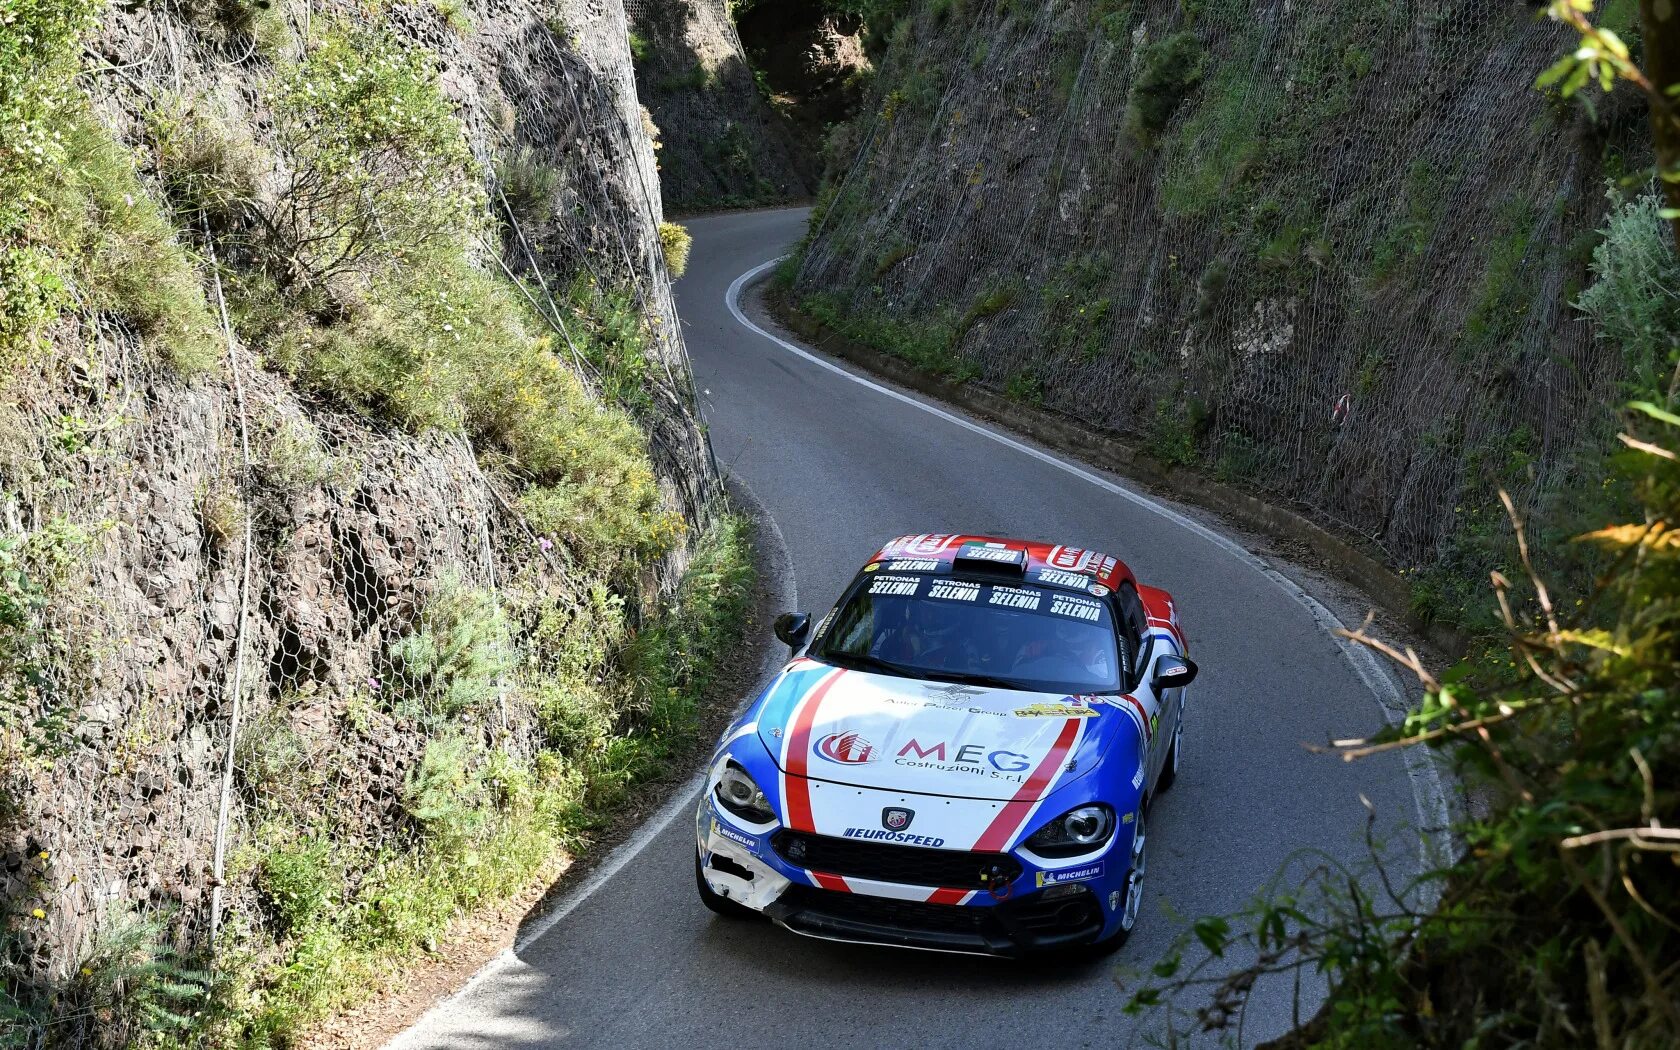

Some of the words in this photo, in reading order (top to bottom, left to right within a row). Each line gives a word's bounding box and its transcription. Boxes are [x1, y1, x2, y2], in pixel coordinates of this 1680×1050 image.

[966, 549, 1017, 562] SELENIA
[888, 560, 938, 571] SELENIA
[874, 575, 920, 583] PETRONAS
[932, 579, 981, 589] PETRONAS
[1038, 572, 1089, 589] SELENIA
[868, 581, 919, 596] SELENIA
[928, 585, 980, 602] SELENIA
[992, 585, 1041, 597] PETRONAS
[989, 592, 1040, 610] SELENIA
[1052, 594, 1101, 608] PETRONAS
[1050, 600, 1100, 622] SELENIA
[968, 707, 1007, 717] Group
[896, 738, 1031, 772] MEG
[894, 758, 985, 776] Costruzioni
[990, 771, 1024, 784] S.r.l.
[721, 828, 756, 847] MICHELIN
[853, 828, 945, 848] EUROSPEED
[1057, 867, 1100, 881] MICHELIN
